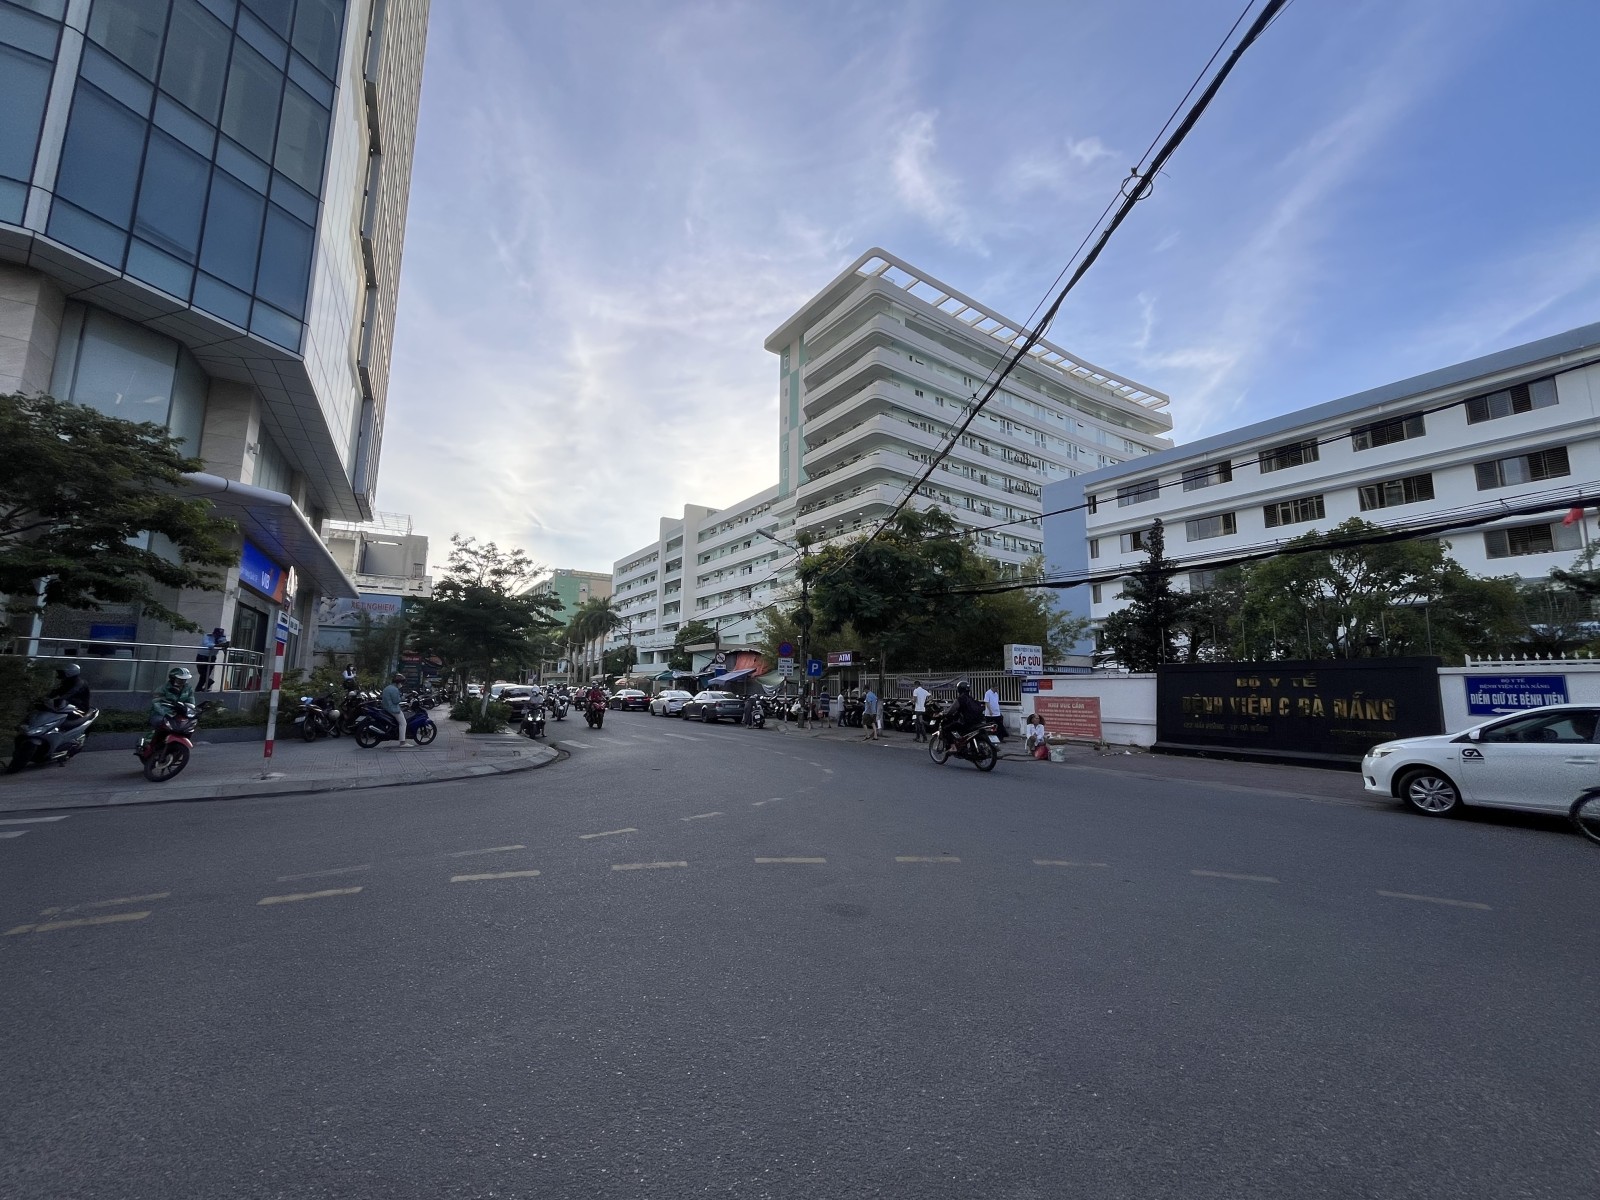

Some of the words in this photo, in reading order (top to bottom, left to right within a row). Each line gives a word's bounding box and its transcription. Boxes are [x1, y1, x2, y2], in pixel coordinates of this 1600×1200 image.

[838, 654, 851, 662] ATM
[1013, 652, 1027, 666] CẤP
[1028, 655, 1041, 667] CỨU
[811, 663, 819, 673] P
[1236, 675, 1261, 691] BỘ
[1268, 677, 1281, 688] Y
[1290, 672, 1317, 688] TẾ
[1182, 693, 1223, 718] BỆNH
[1229, 693, 1272, 720] VIỆN
[1278, 697, 1290, 718] C
[1297, 693, 1326, 718] ĐÀ
[1333, 691, 1396, 721] NẴNG
[1470, 689, 1491, 705] ĐIỂM
[1491, 692, 1506, 705] GIỮ
[1507, 693, 1518, 705] XE
[1519, 691, 1543, 708] BỆNH
